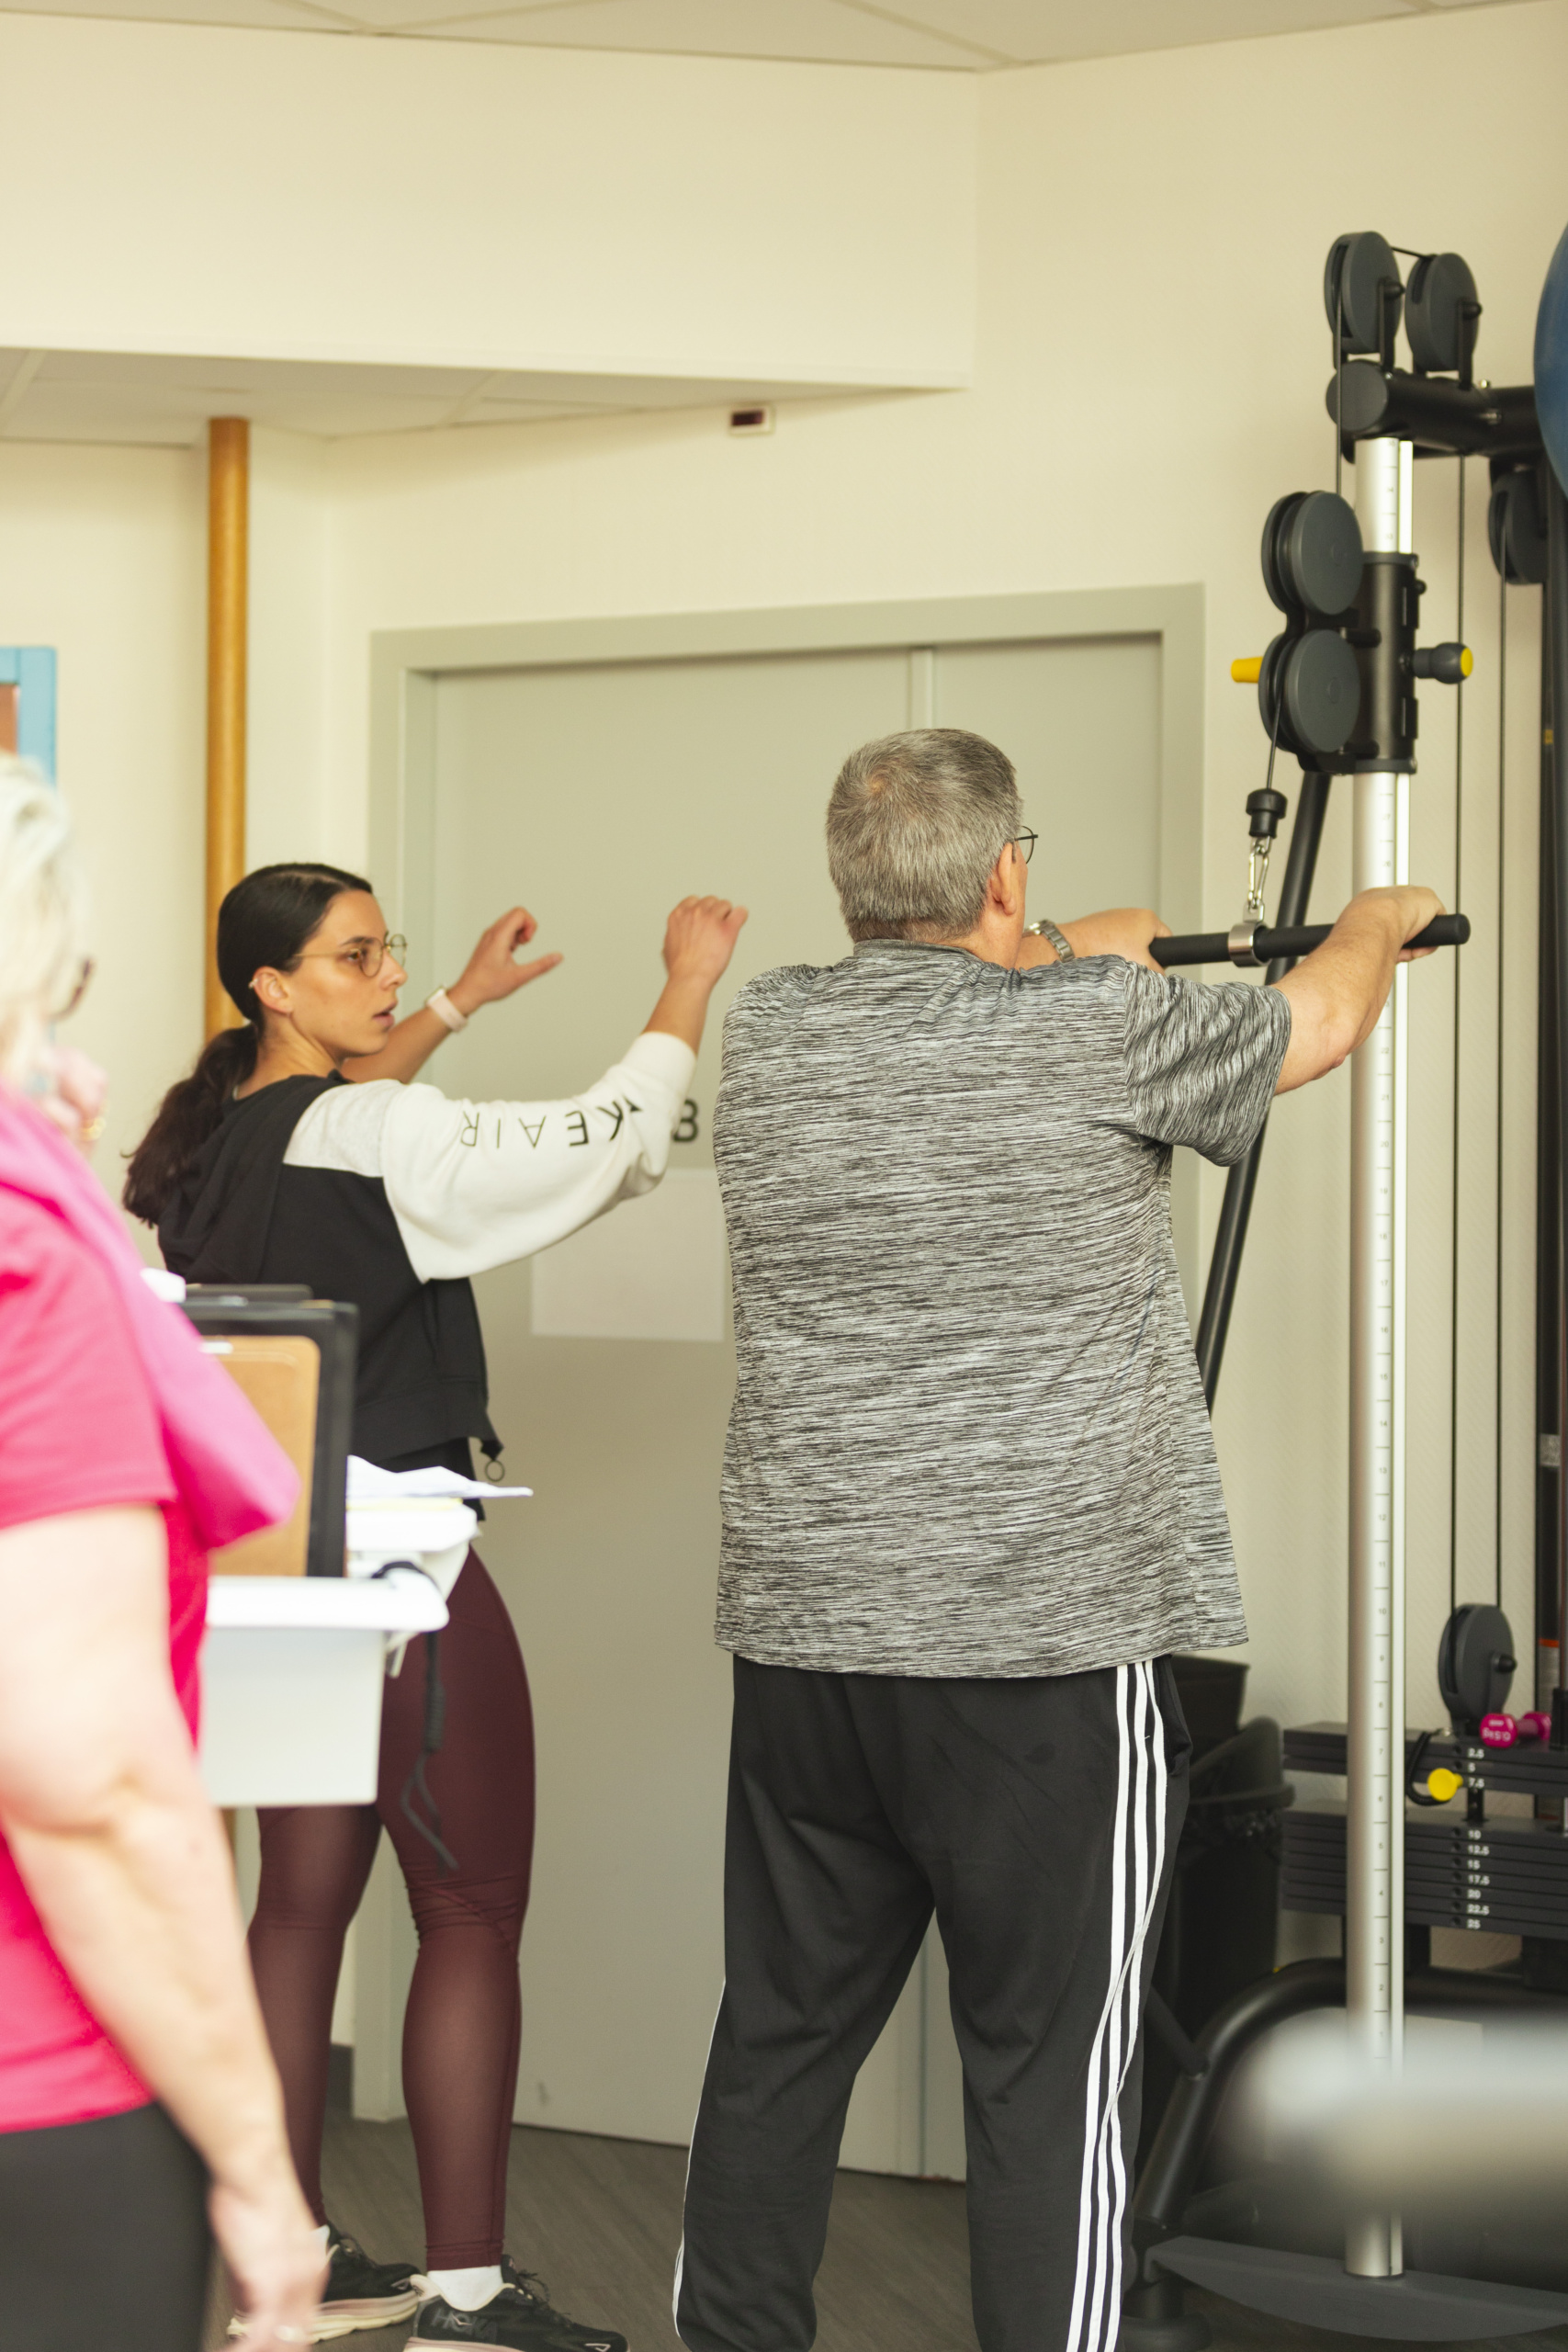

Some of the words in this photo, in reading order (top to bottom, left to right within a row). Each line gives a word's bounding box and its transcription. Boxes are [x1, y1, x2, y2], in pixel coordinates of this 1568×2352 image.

[1380, 1046, 1390, 1055] 22
[1381, 1093, 1390, 1102] 21
[460, 1110, 547, 1148] AIR
[1380, 1140, 1390, 1148] 20
[1380, 1187, 1389, 1195] 19
[1379, 1232, 1388, 1240] 18
[1380, 1279, 1389, 1287] 17
[1380, 1326, 1389, 1334] 16
[1380, 1373, 1389, 1381] 15
[1378, 1466, 1388, 1475] 13
[1378, 1513, 1387, 1521] 12
[1378, 1560, 1386, 1568] 11
[1378, 1607, 1387, 1616] 10
[1379, 1654, 1385, 1662] 9
[1378, 1747, 1384, 1756] 7
[1467, 1747, 1484, 1758] 2.5
[1468, 1762, 1476, 1773] 5
[1468, 1778, 1484, 1789] 7.5
[1467, 1830, 1482, 1840] 10
[1467, 1845, 1489, 1856] 12.5
[1467, 1860, 1481, 1871] 15
[1468, 1874, 1490, 1885] 17.5
[1378, 1889, 1385, 1897] 4
[1467, 1889, 1482, 1899] 20
[1467, 1904, 1490, 1916] 22.5
[1467, 1918, 1481, 1929] 25
[1379, 1936, 1385, 1945] 3
[1378, 1984, 1384, 1992] 2
